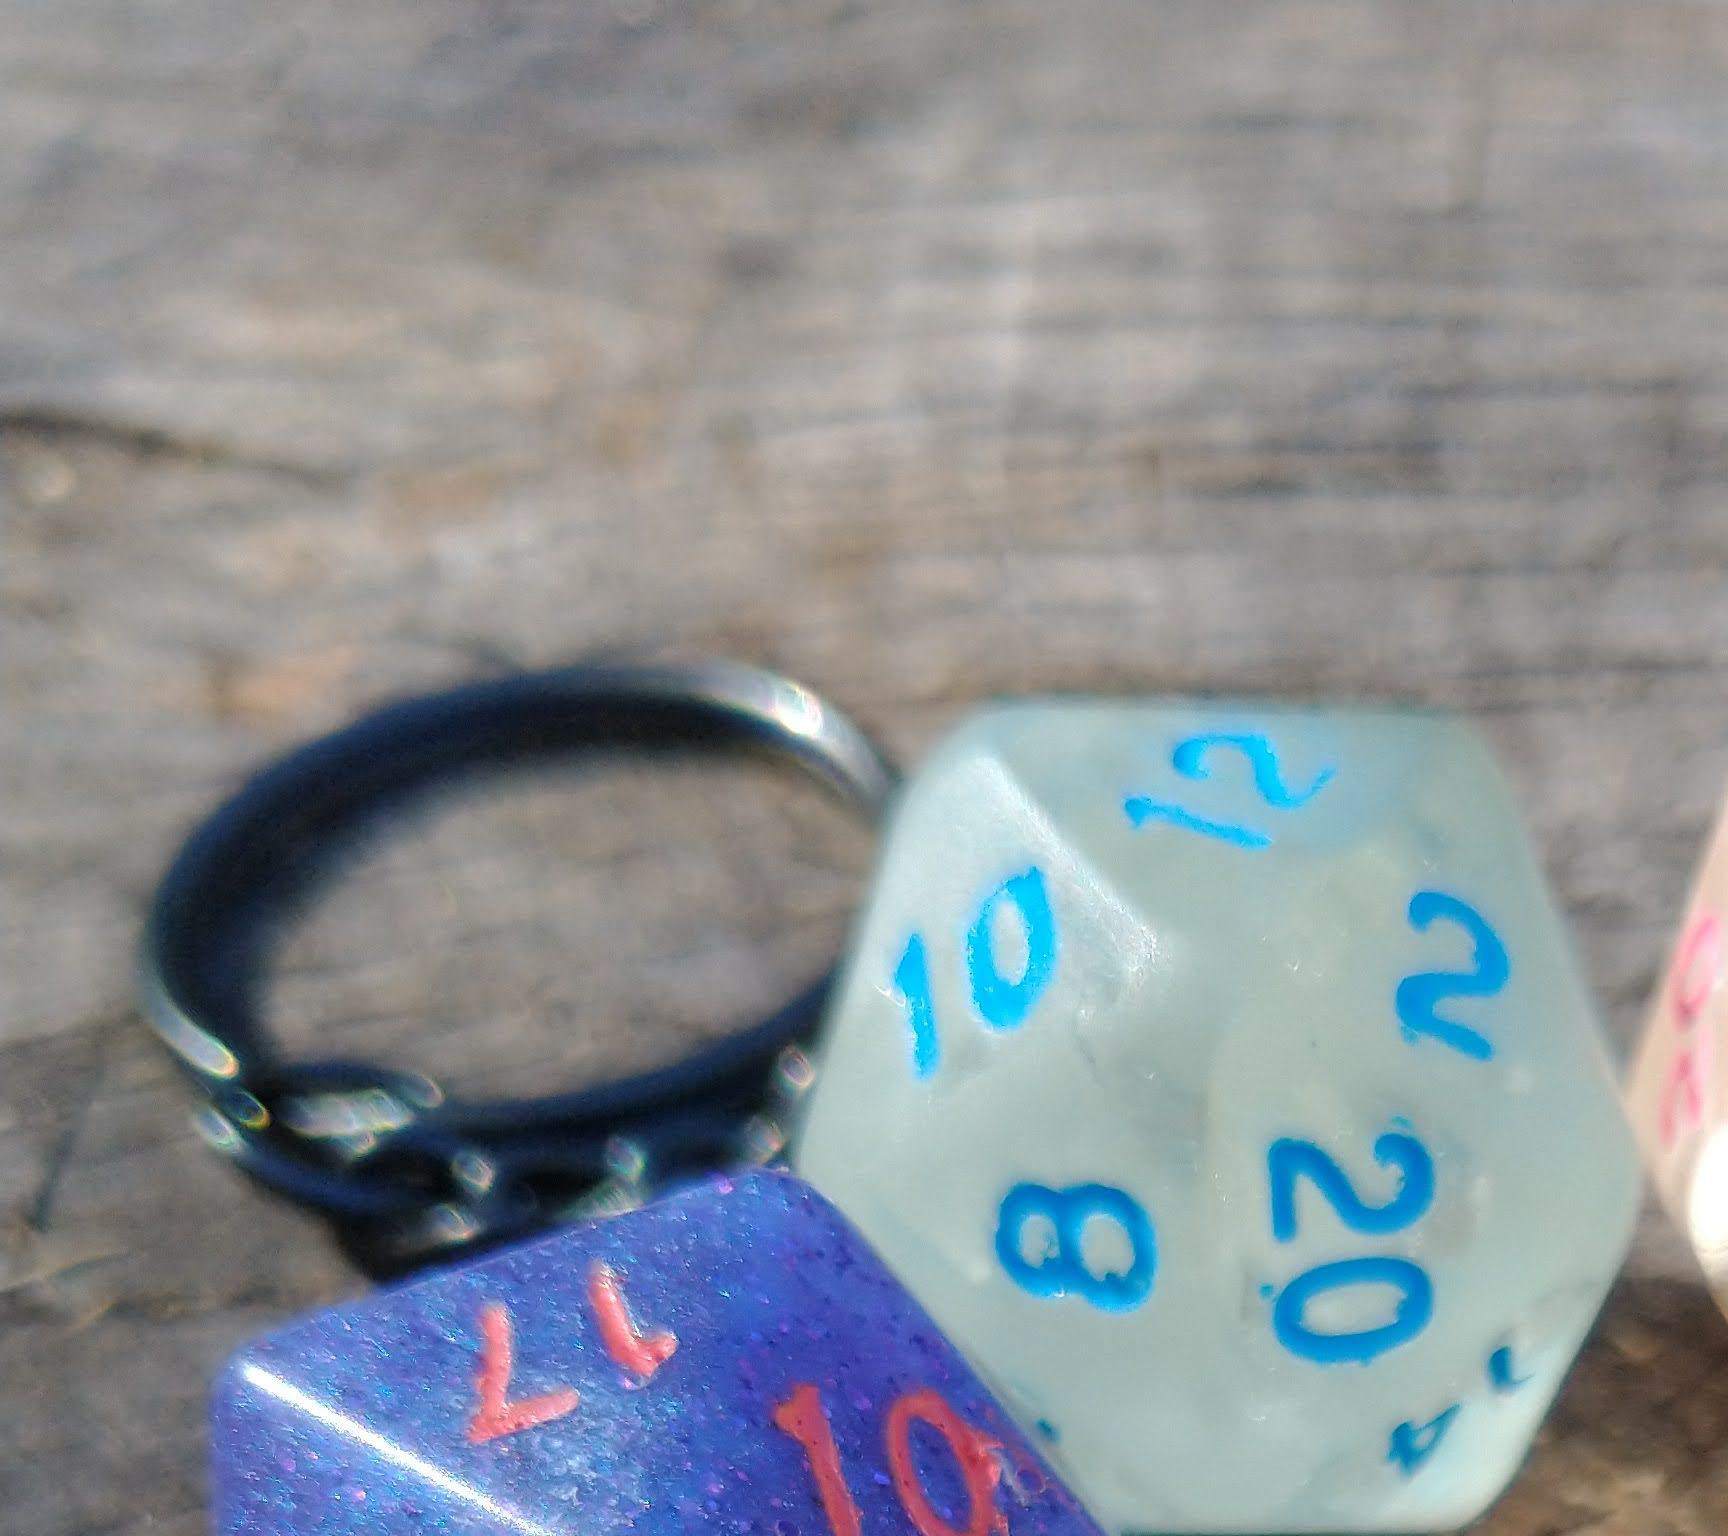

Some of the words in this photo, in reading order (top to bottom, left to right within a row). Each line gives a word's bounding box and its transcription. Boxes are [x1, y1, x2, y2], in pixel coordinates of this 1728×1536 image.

[1125, 732, 1337, 850] 12
[895, 865, 1056, 1080] 10
[1396, 890, 1511, 1062] 2
[995, 1183, 1159, 1313] 8
[1265, 1120, 1435, 1366] 20
[467, 1261, 679, 1445] 17
